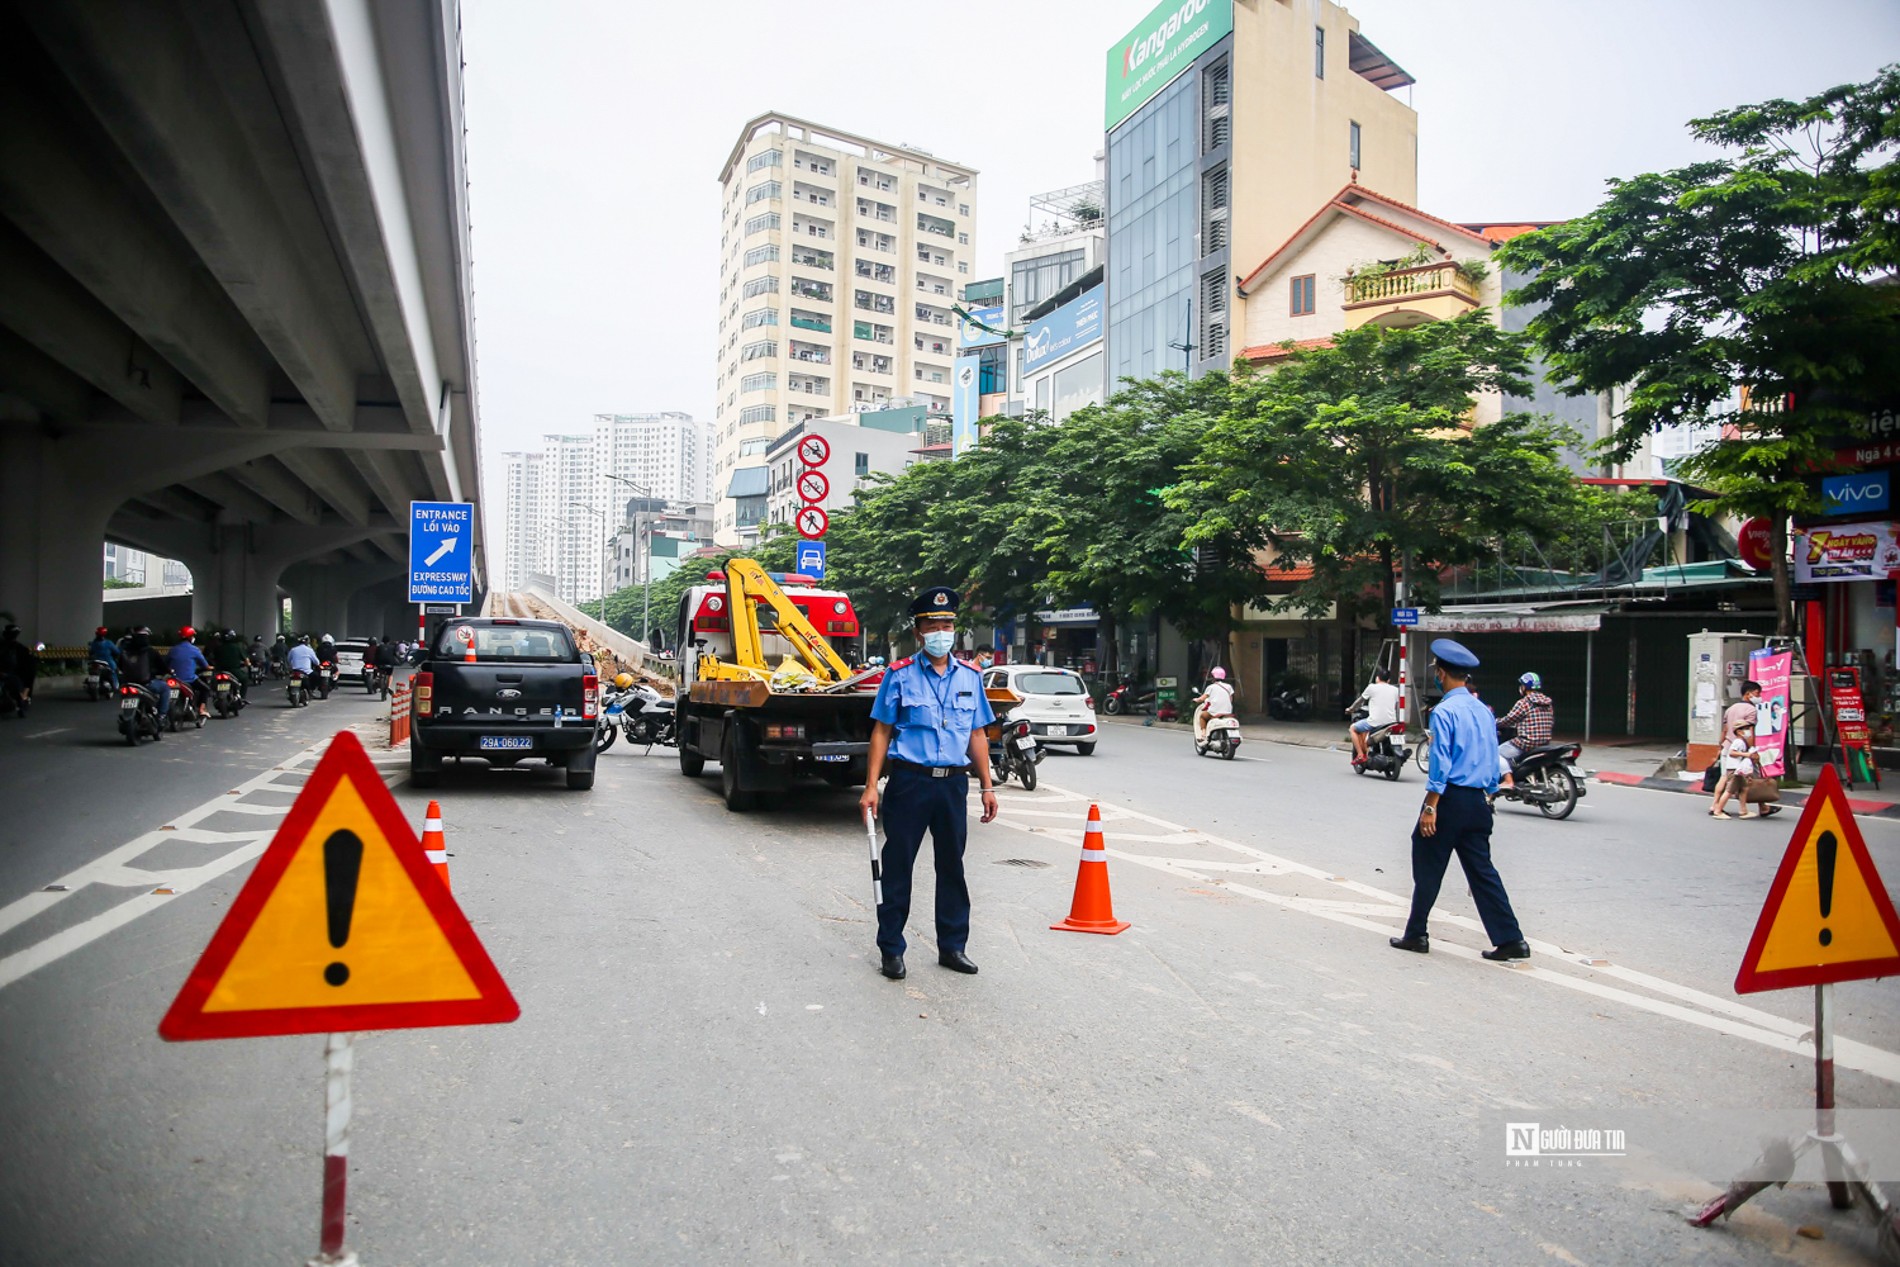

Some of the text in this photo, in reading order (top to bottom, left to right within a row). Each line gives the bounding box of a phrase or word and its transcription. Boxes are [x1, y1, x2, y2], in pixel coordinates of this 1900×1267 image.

[1856, 446, 1880, 463] Ngã
[1884, 445, 1891, 459] 4
[1829, 483, 1883, 501] vivo
[416, 510, 468, 520] ENTRANCE
[423, 519, 460, 533] LỐI VÀO
[414, 572, 468, 582] EXPRESSWAY
[412, 582, 470, 595] ĐƯỜNG CAO TỐC
[438, 706, 577, 716] RANGER
